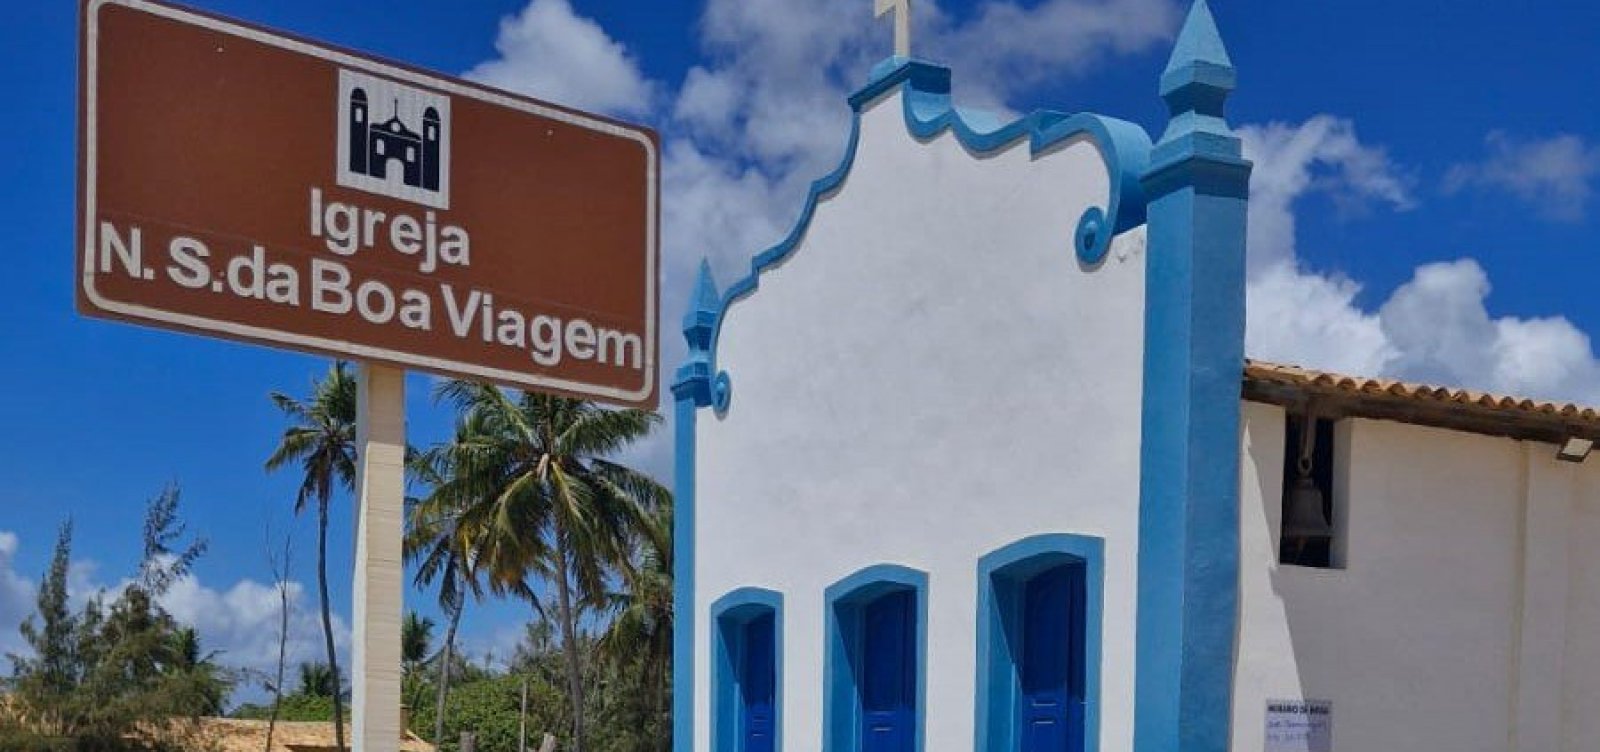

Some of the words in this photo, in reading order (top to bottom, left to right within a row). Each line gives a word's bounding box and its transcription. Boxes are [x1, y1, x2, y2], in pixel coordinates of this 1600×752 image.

[310, 187, 470, 273] Igreja
[100, 221, 155, 280] N.
[311, 258, 431, 331] Boa
[440, 283, 643, 370] Viagem
